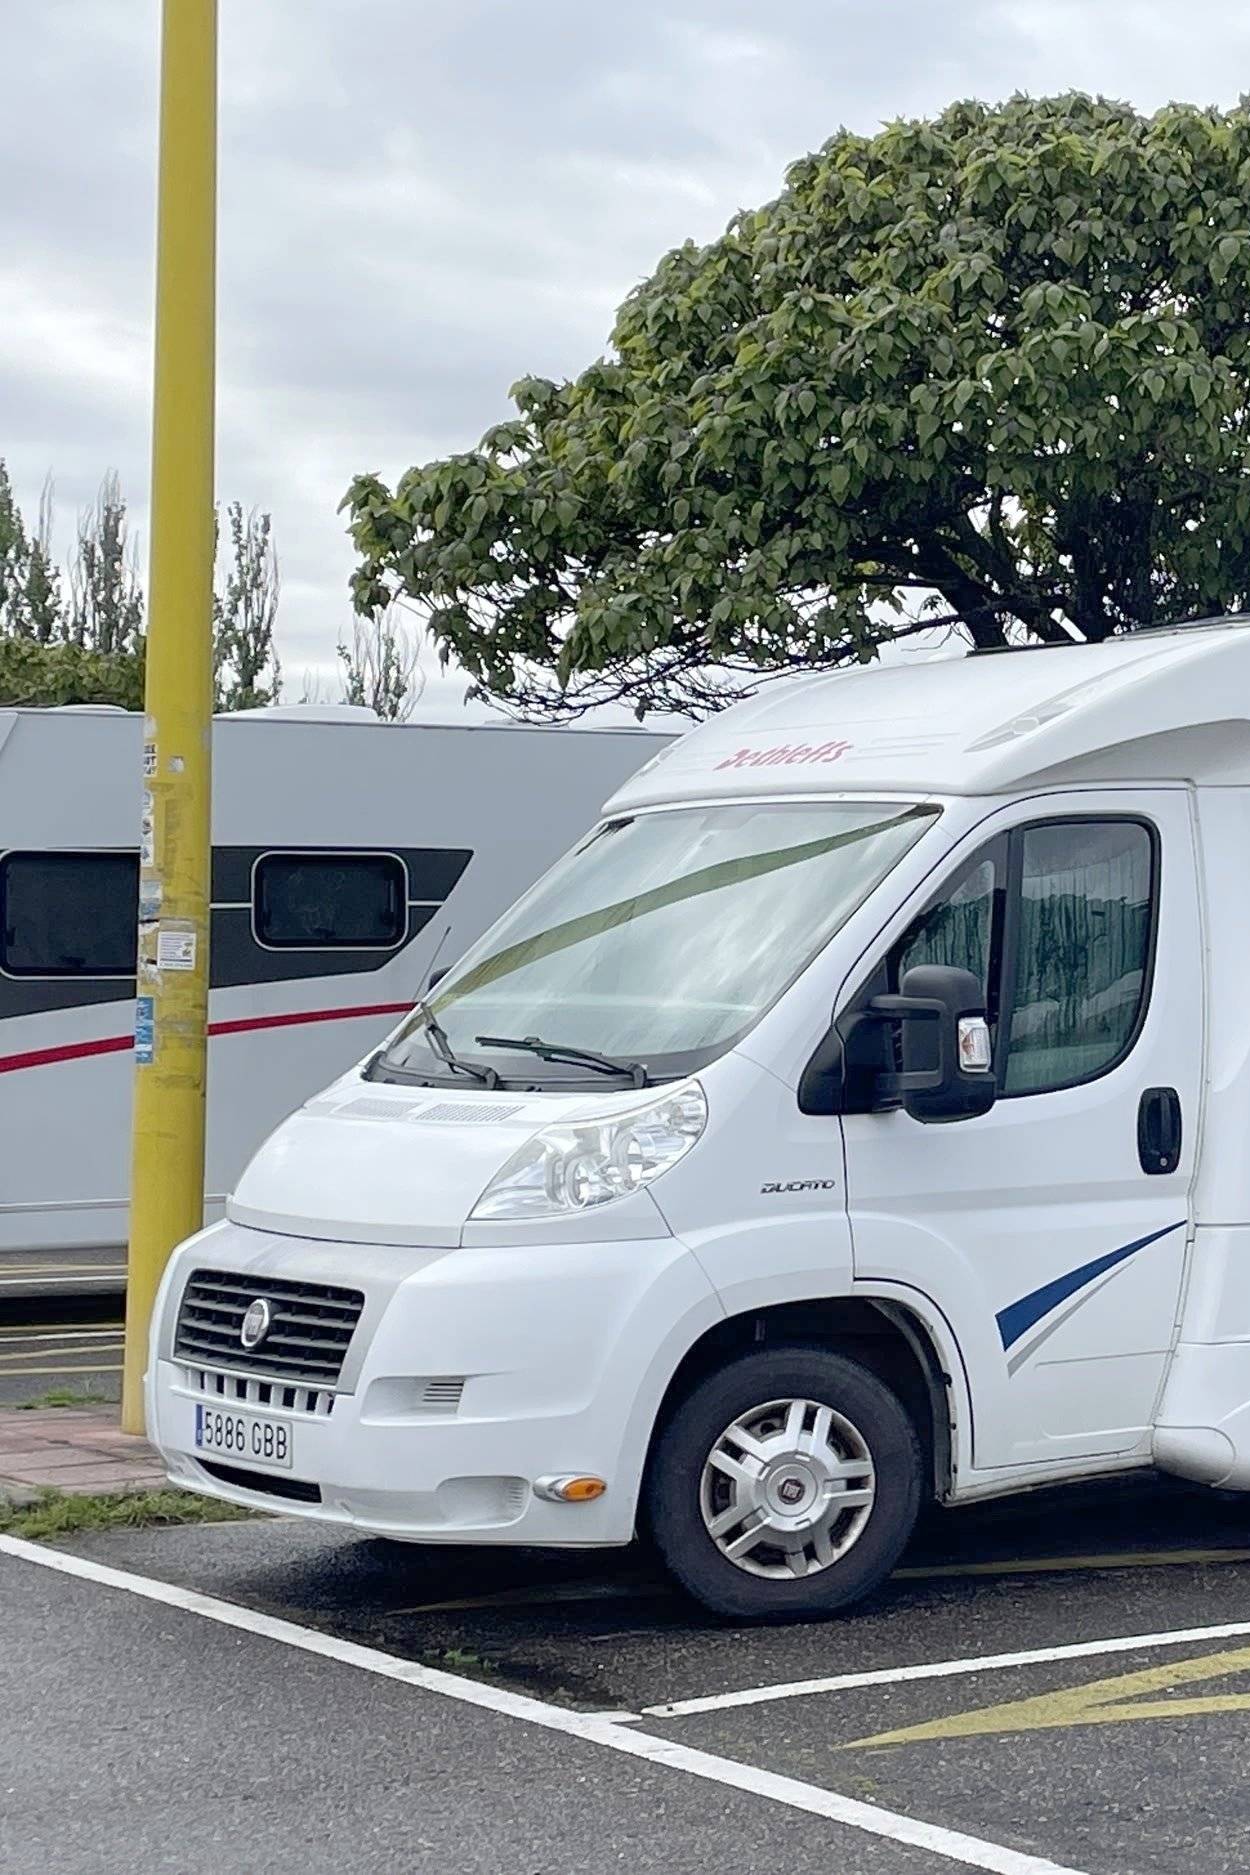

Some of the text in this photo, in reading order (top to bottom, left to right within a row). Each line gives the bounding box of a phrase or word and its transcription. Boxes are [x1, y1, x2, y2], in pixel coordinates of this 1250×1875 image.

[712, 740, 854, 771] Dethleffs
[760, 1179, 836, 1194] DUCATO
[205, 1411, 287, 1459] 5886 GBB
